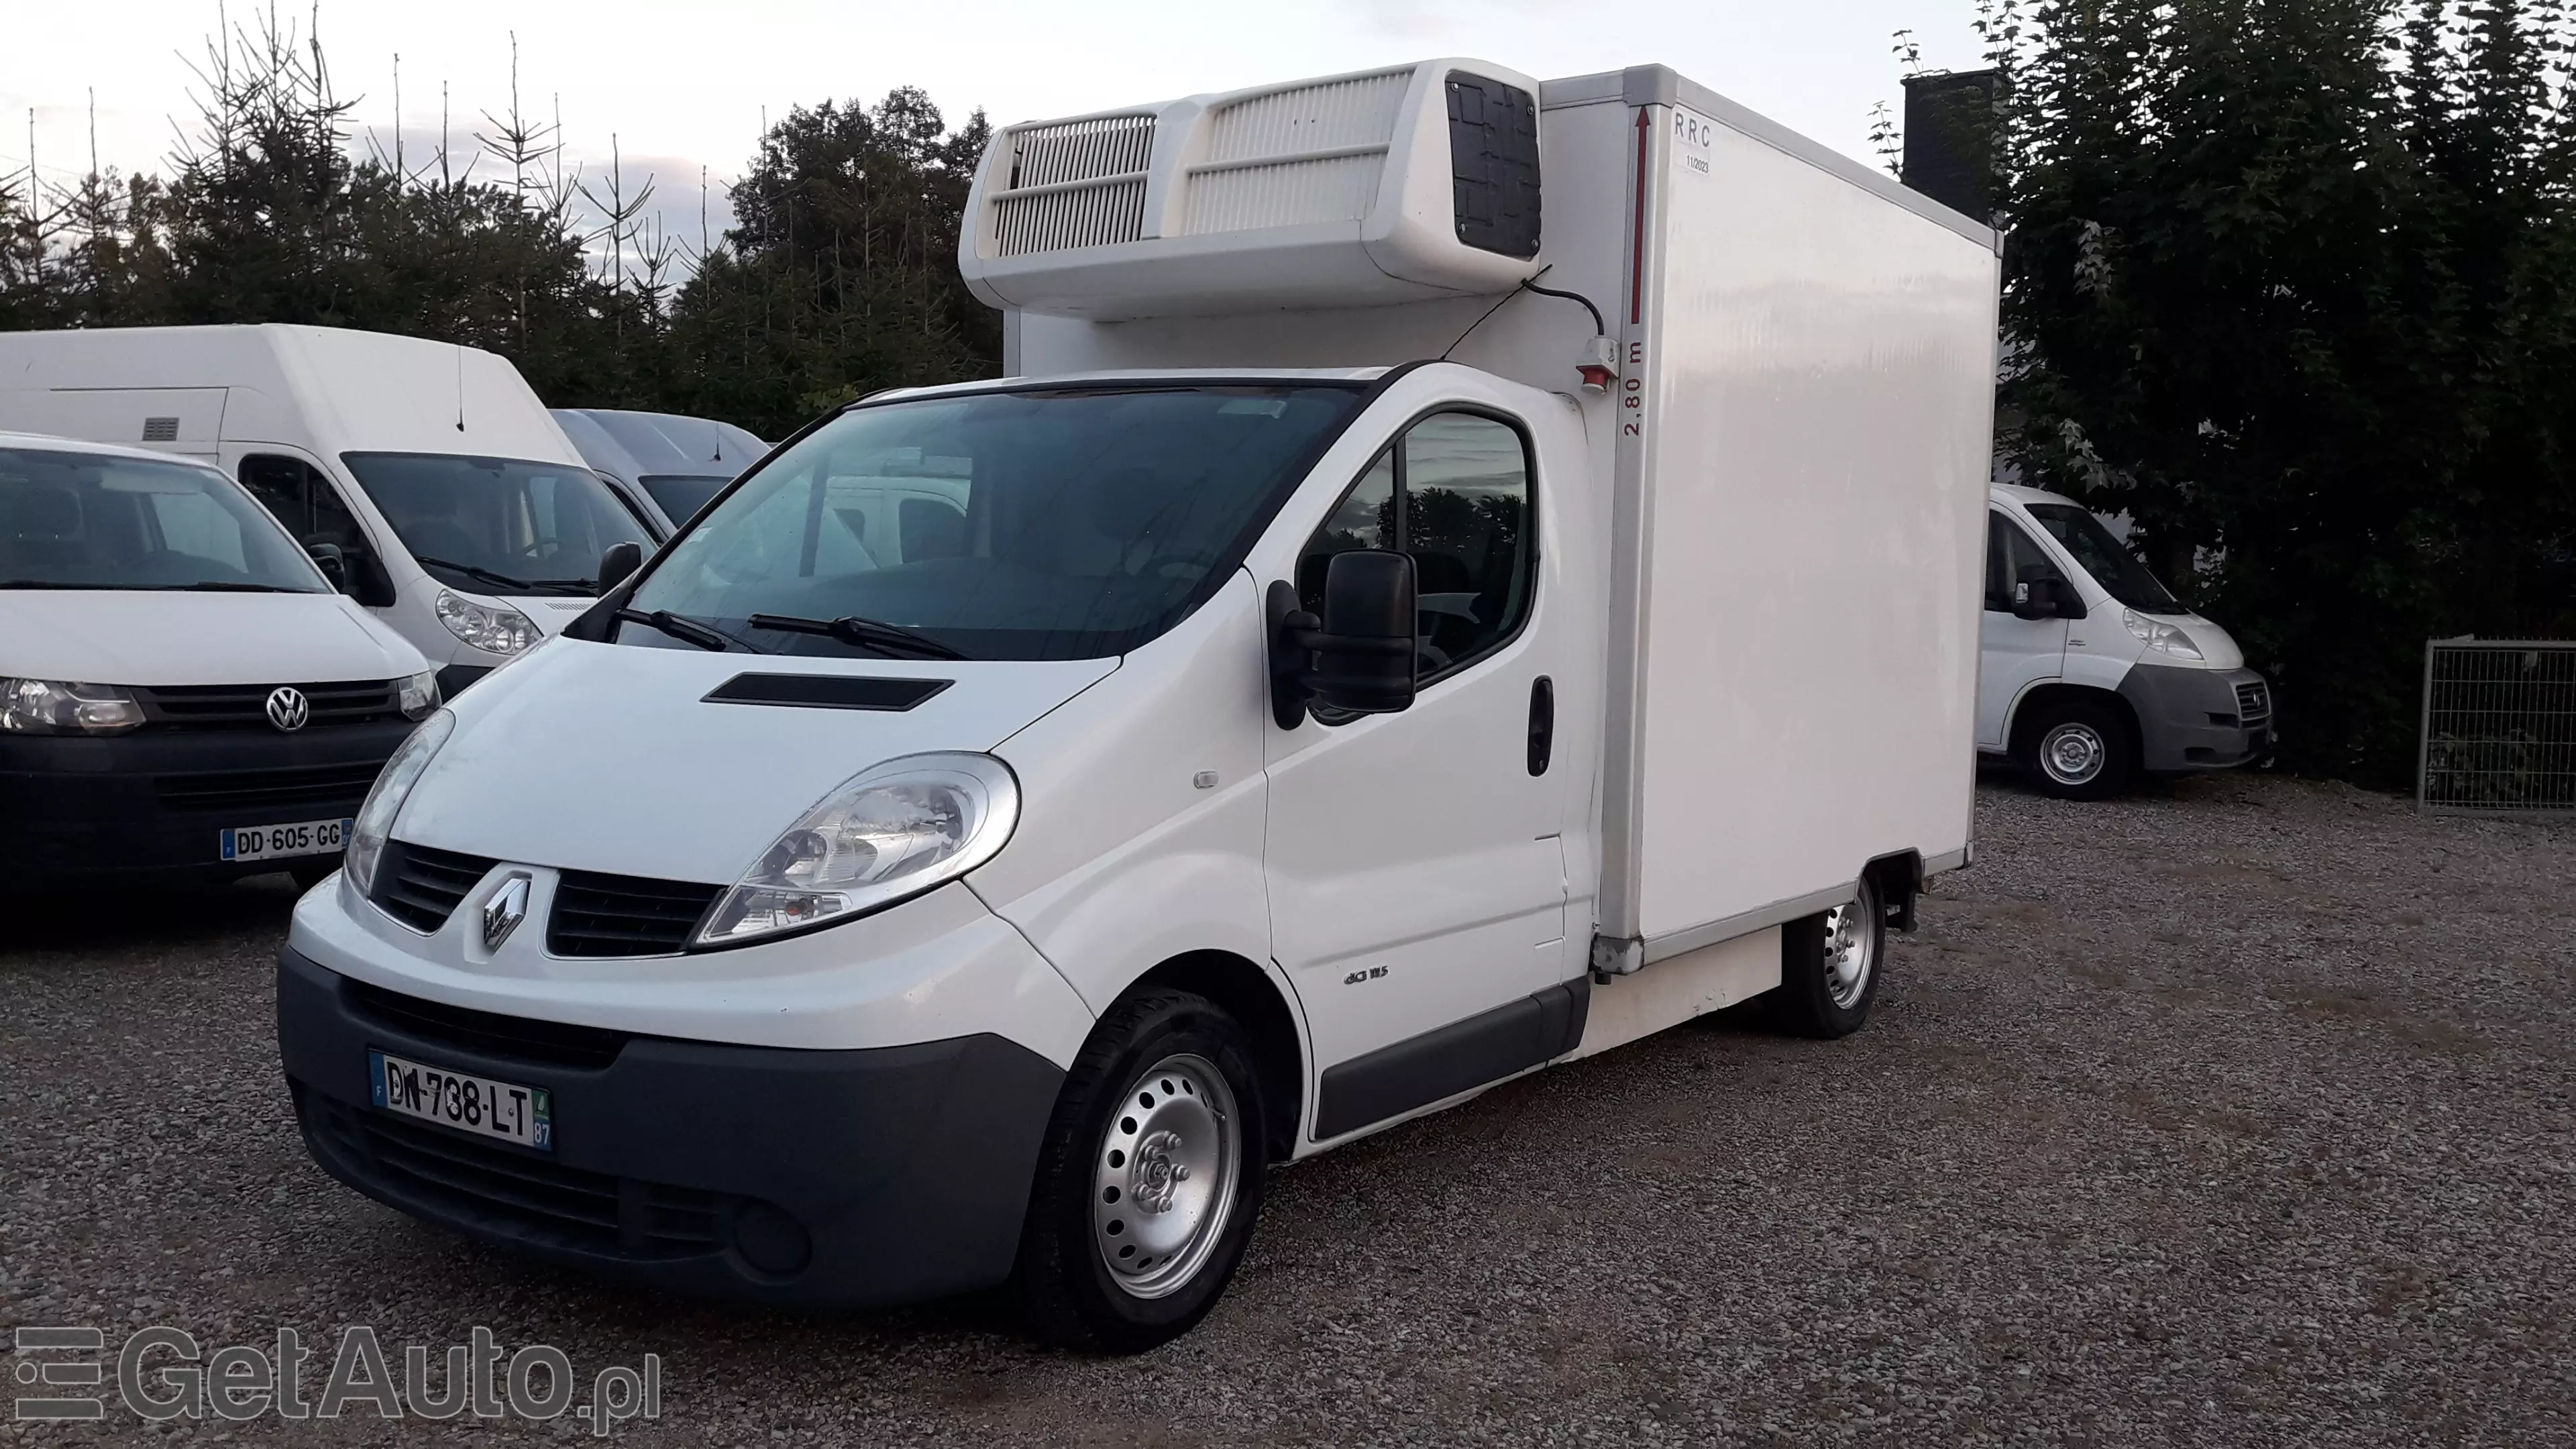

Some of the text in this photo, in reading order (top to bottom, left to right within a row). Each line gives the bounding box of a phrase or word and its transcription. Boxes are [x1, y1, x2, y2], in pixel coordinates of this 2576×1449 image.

[1686, 154, 1709, 174] 11/2023
[1629, 341, 1642, 364] m
[534, 1122, 550, 1146] 87
